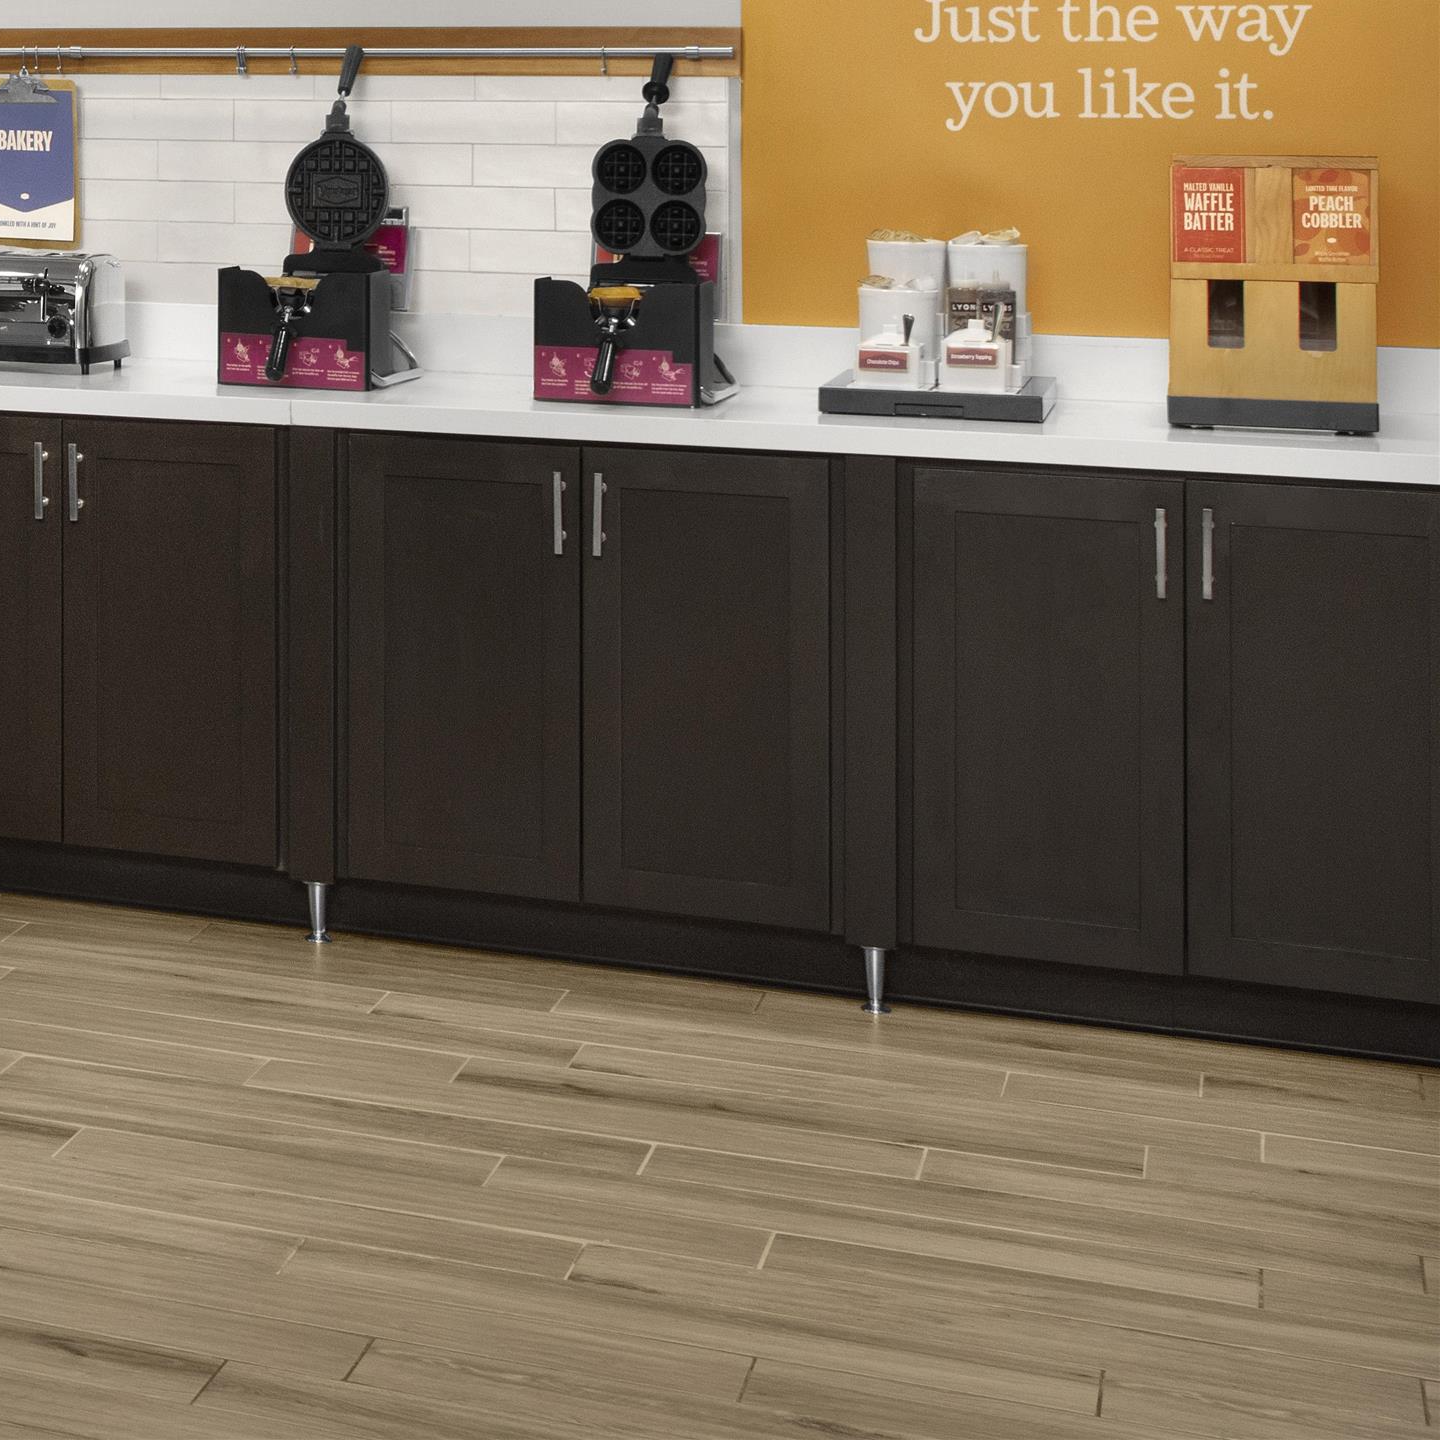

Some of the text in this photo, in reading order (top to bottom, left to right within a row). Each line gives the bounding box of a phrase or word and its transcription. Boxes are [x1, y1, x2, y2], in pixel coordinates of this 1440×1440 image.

[1175, 4, 1312, 56] way
[945, 67, 1274, 132] you like it.
[1183, 183, 1234, 192] MALTED VANILLA
[1183, 192, 1235, 212] WAFFLE
[1309, 195, 1354, 211] PEACH
[1183, 212, 1234, 231] BATTER
[1301, 212, 1362, 229] COBBLER
[951, 303, 977, 311] LYON
[982, 304, 1013, 312] LYS
